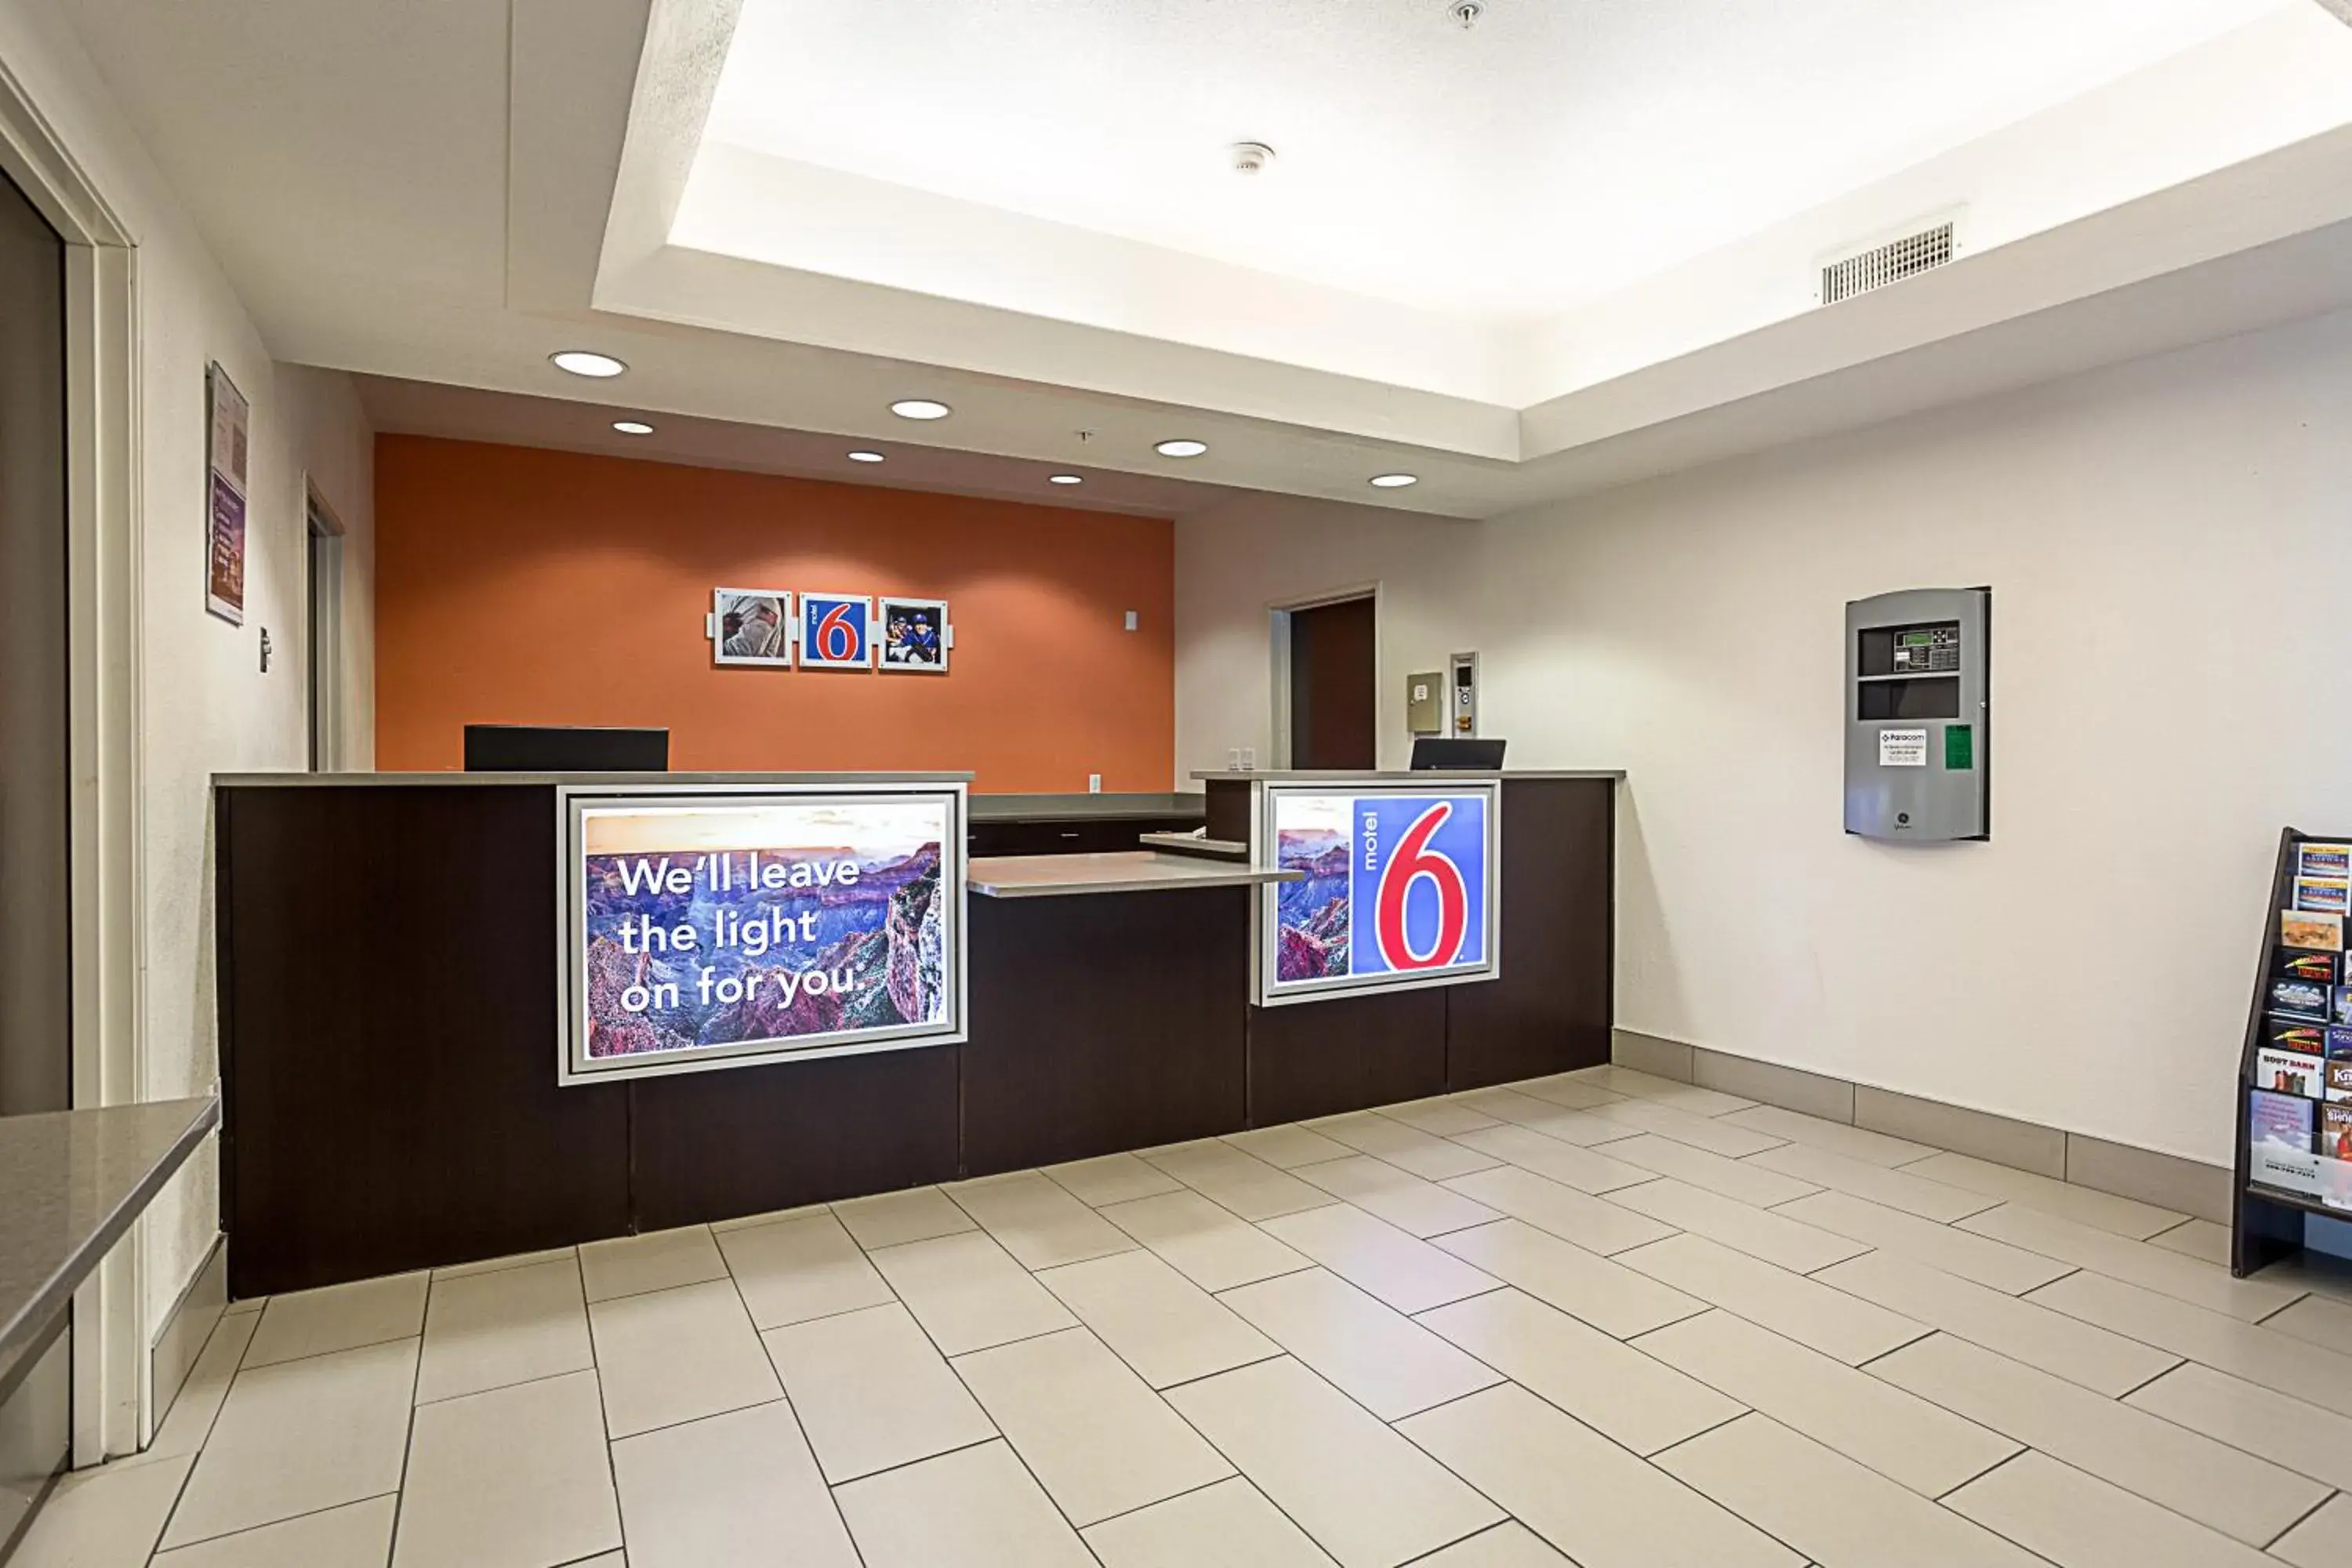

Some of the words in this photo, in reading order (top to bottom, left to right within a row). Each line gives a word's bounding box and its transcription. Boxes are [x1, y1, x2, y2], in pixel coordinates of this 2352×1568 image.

[816, 603, 858, 662] 6
[618, 853, 731, 896] We'll
[750, 852, 860, 890] leave
[1362, 811, 1378, 871] motel
[1374, 800, 1468, 971] 6
[618, 913, 698, 954] the
[715, 906, 816, 955] light
[620, 982, 679, 1011] on
[696, 965, 763, 1005] for
